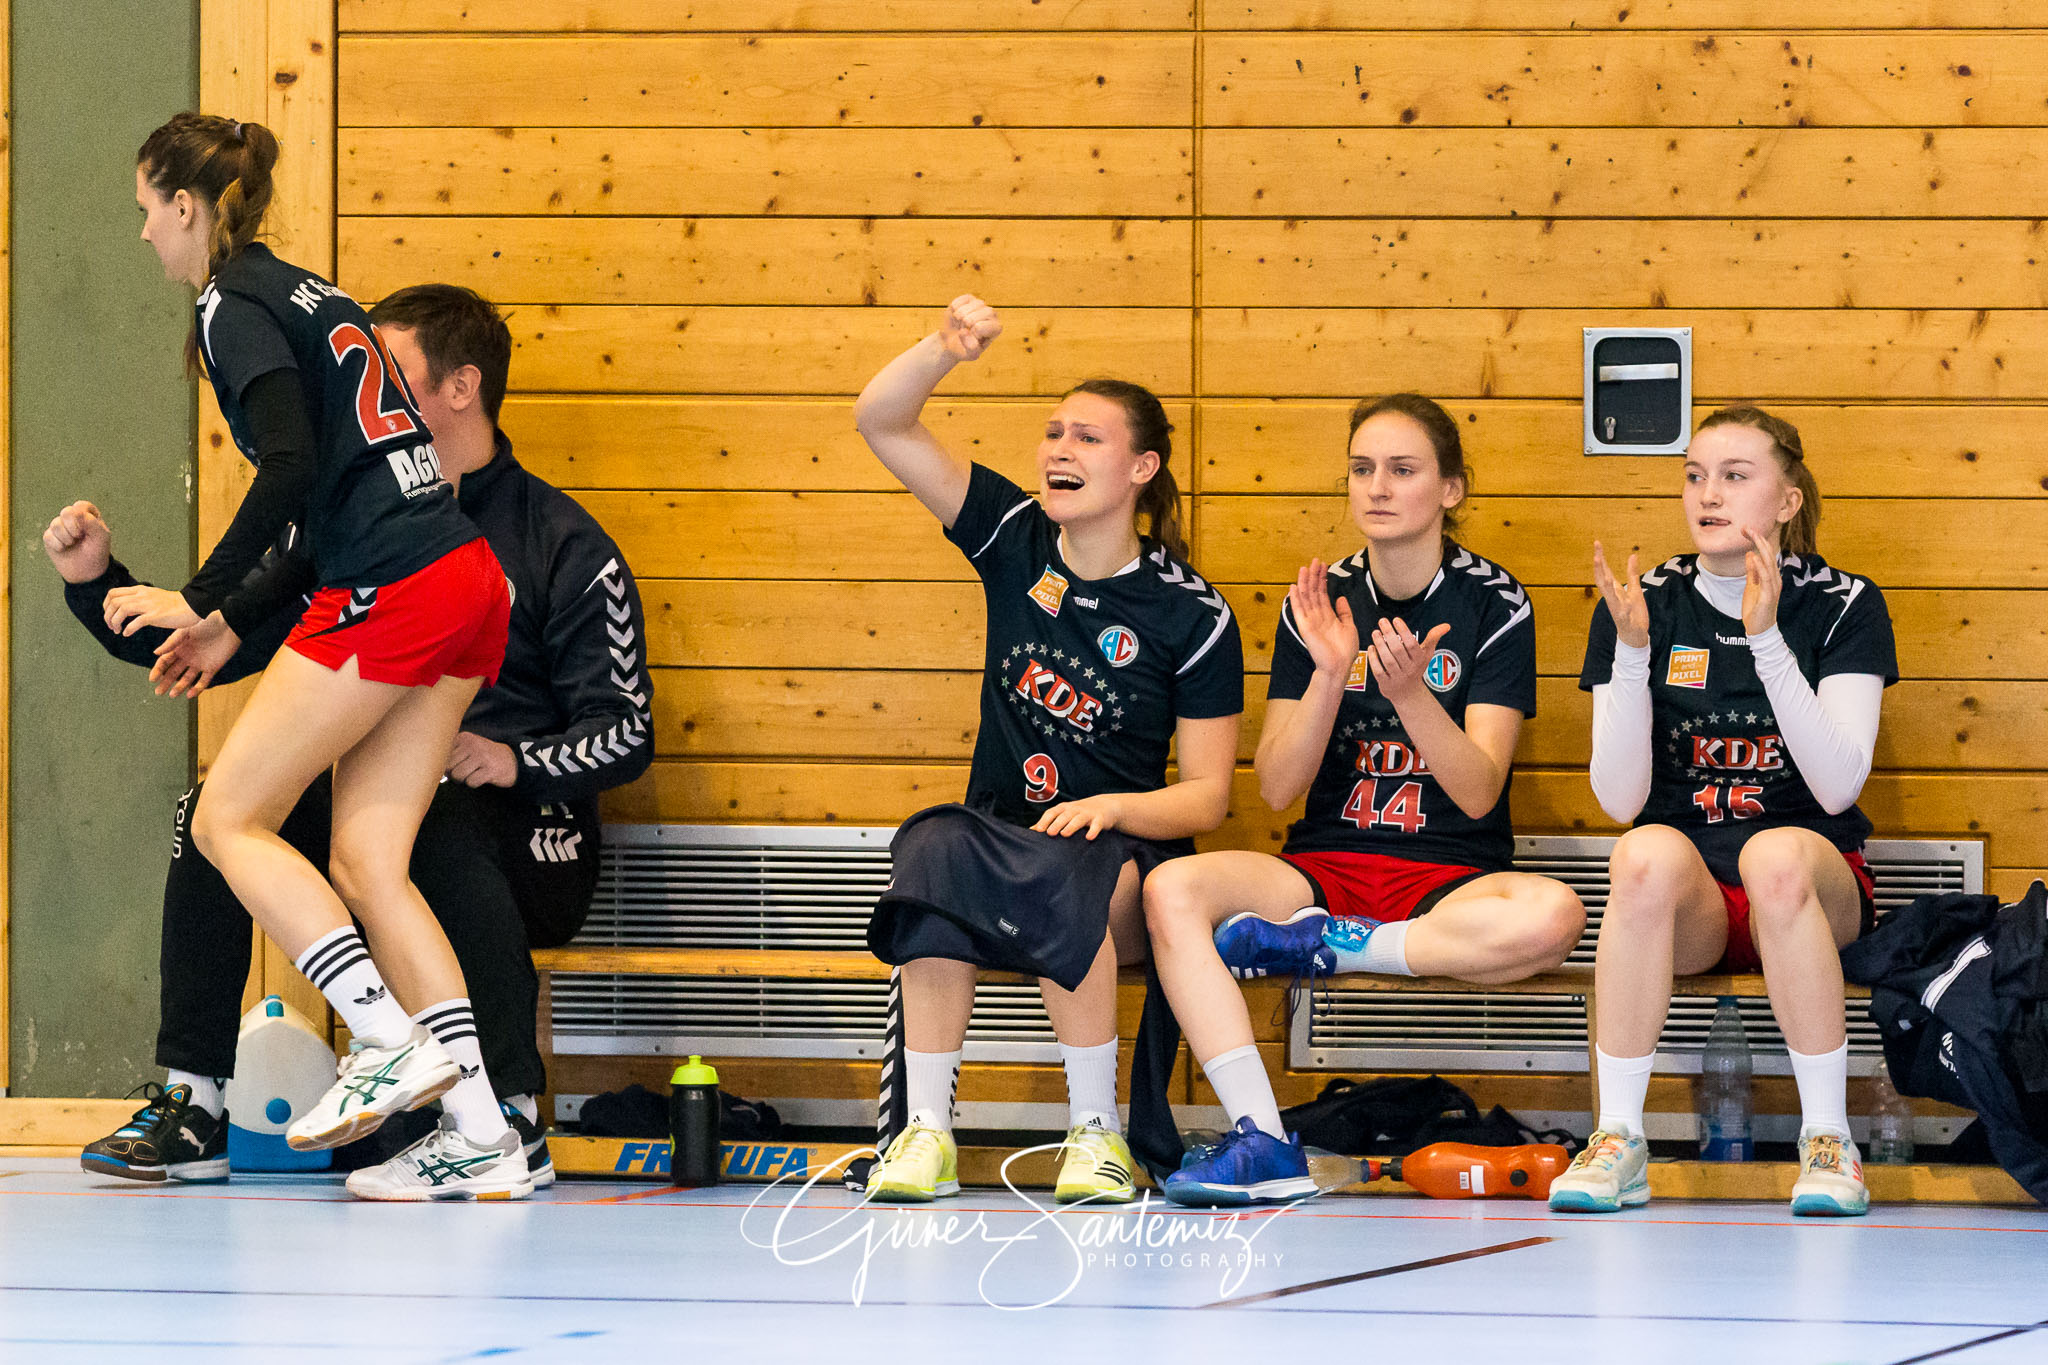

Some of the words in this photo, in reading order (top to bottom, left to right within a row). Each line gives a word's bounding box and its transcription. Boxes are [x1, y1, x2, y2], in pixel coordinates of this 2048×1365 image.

[289, 282, 323, 316] HC
[328, 322, 423, 446] 2
[1672, 670, 1702, 681] PIXEL
[1674, 654, 1705, 664] PRINT
[1015, 658, 1103, 733] KDE
[1691, 734, 1784, 772] KDE
[1023, 752, 1059, 803] 9
[1341, 778, 1427, 834] 44
[1693, 784, 1766, 824] 15
